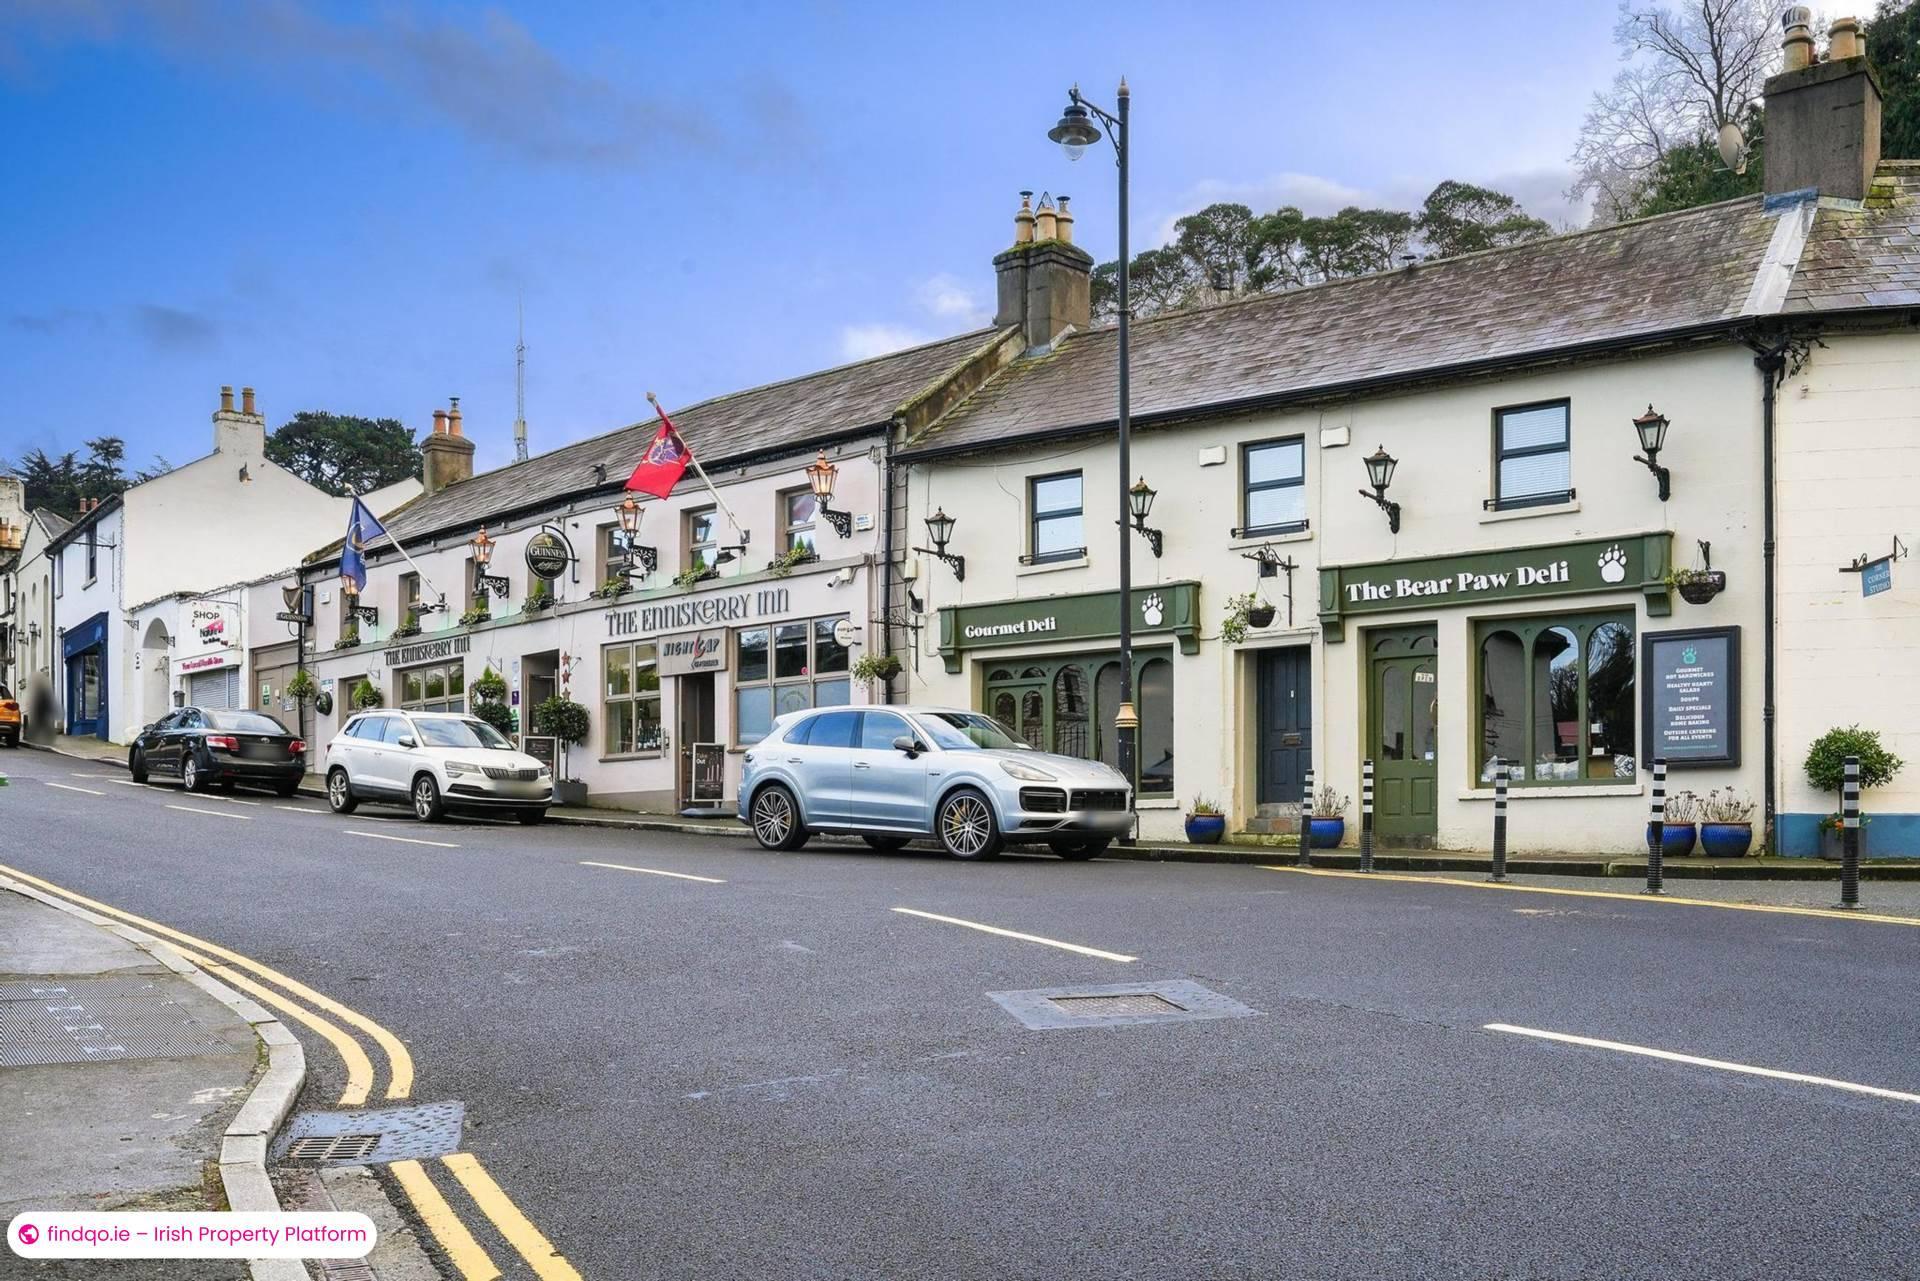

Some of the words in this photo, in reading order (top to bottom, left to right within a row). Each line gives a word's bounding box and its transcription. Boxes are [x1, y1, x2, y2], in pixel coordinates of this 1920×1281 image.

[530, 546, 566, 558] GUINNESS
[1345, 582, 1392, 602] The
[1395, 577, 1452, 598] Bear
[1457, 571, 1512, 592] Paw
[1516, 560, 1570, 587] Deli
[193, 611, 220, 619] SHOP
[605, 609, 638, 637] THE
[964, 619, 1025, 639] Gourmet
[1027, 616, 1057, 632] Deli
[384, 647, 401, 666] THE
